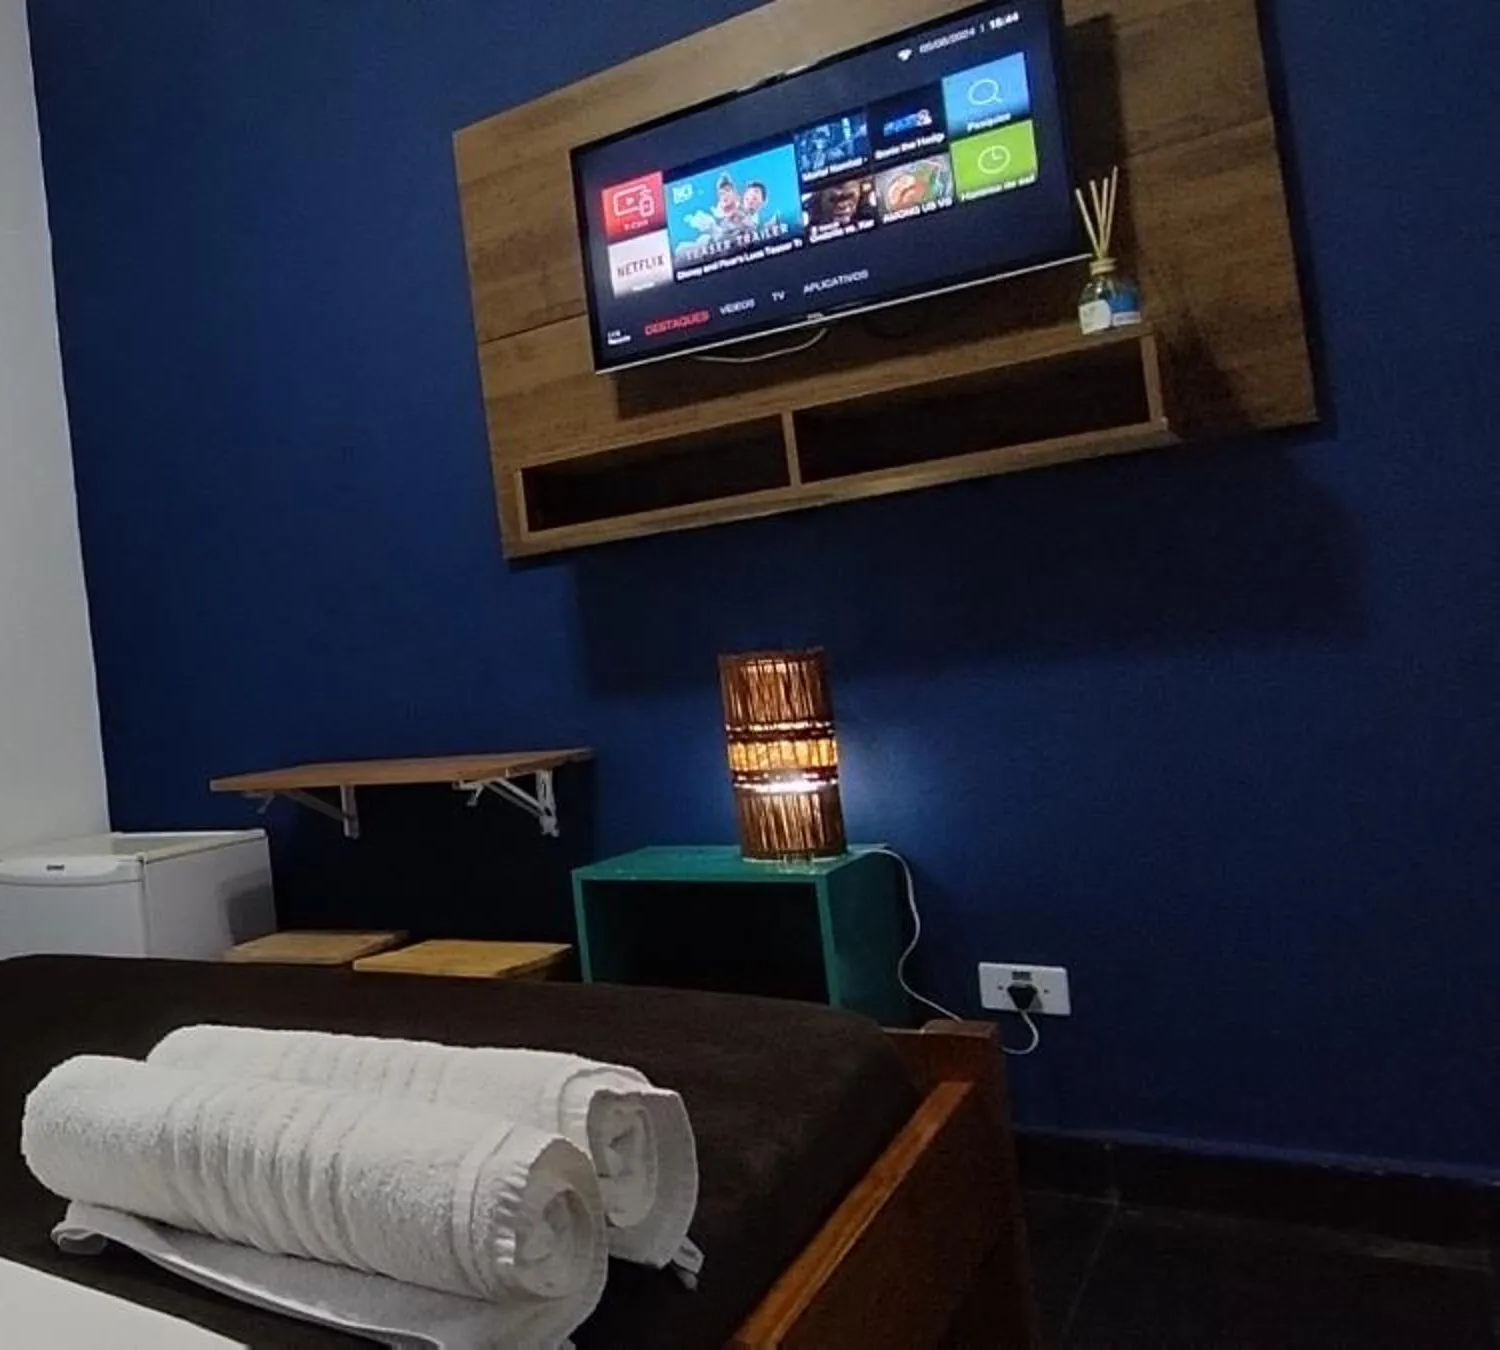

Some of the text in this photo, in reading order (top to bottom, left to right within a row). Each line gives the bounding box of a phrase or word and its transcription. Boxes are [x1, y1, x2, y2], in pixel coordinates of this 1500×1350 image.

[736, 223, 789, 246] TRAILER
[617, 253, 665, 278] NETFLIX
[644, 310, 710, 335] DESTAQUES
[771, 290, 786, 302] TV
[803, 269, 870, 294] APLICATIVOS
